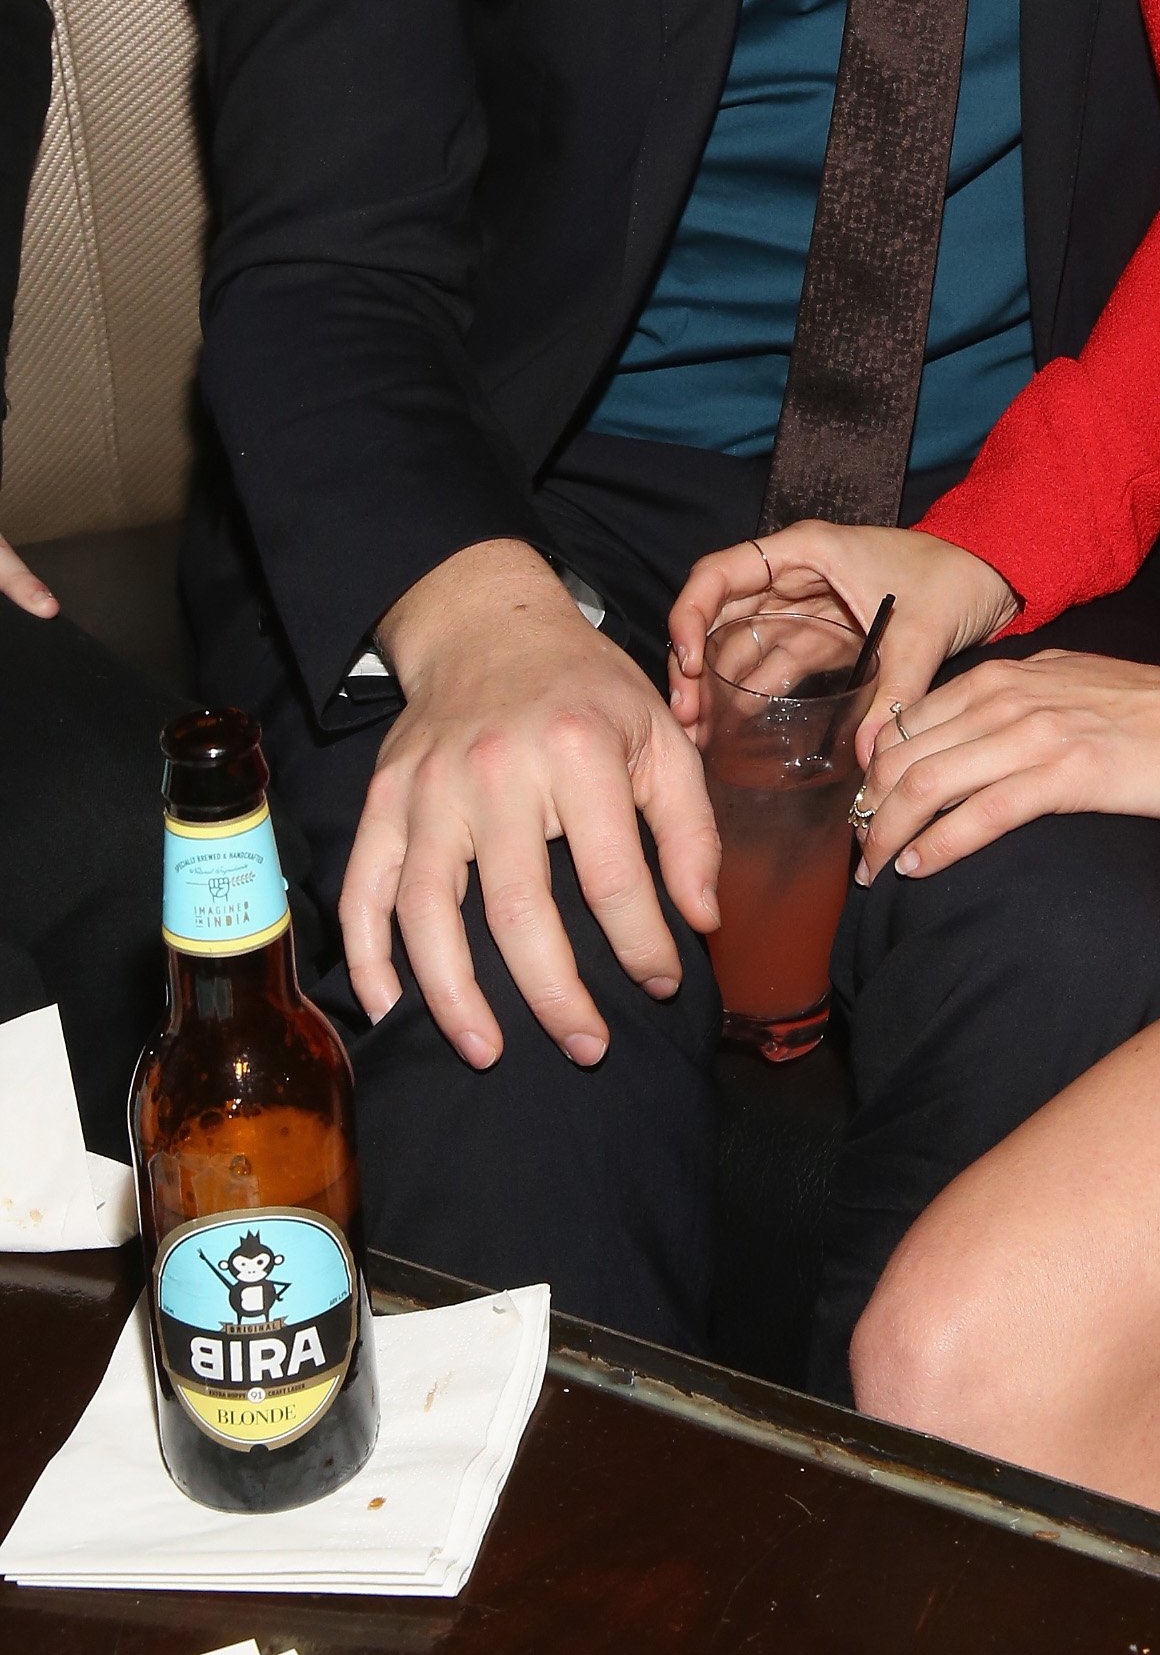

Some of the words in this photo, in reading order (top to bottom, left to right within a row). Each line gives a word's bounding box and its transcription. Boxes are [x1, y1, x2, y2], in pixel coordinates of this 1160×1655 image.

[174, 857, 196, 873] SPECIALLY
[197, 853, 220, 863] BREWED
[229, 852, 264, 865] HANDCRAFTED
[194, 901, 249, 915] IMAGINED
[207, 912, 250, 928] INDIA
[230, 1324, 277, 1333] ORIGINAL
[190, 1326, 326, 1382] BIRA
[250, 1391, 262, 1400] 91
[268, 1388, 286, 1397] CRAFT
[287, 1384, 305, 1393] LAGER
[218, 1404, 296, 1425] BLONDE
